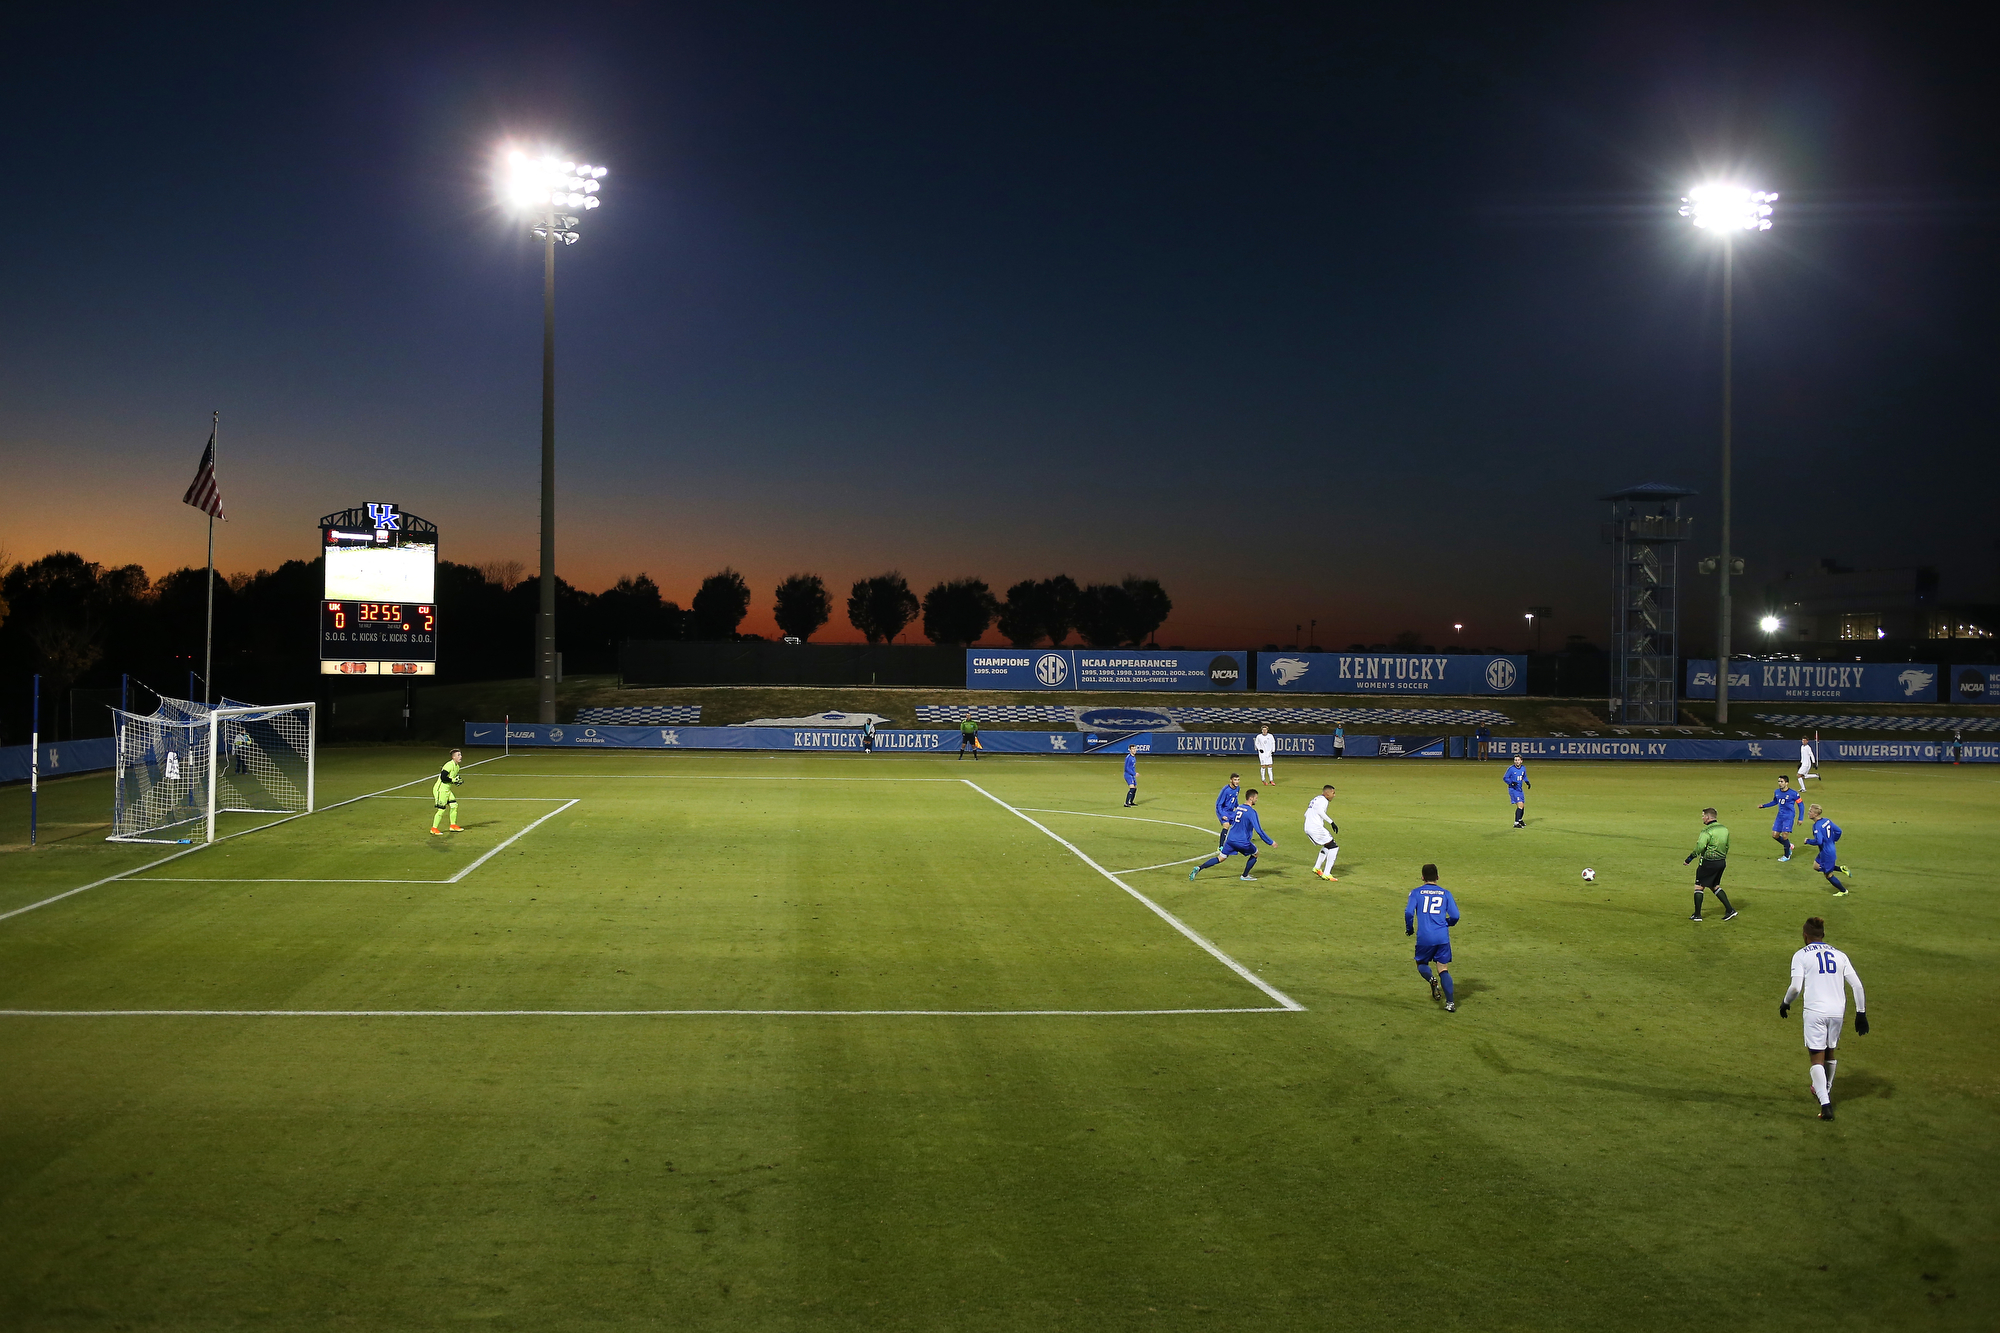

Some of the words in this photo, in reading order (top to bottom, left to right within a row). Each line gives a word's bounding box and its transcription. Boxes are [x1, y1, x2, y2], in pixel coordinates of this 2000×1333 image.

[367, 503, 399, 530] UK
[329, 603, 340, 611] UK
[418, 606, 430, 614] CU
[335, 612, 345, 629] 0
[424, 615, 433, 631] 2
[325, 632, 347, 641] S.O.G.
[359, 632, 378, 642] KICKS
[389, 633, 408, 642] KICKS
[411, 634, 432, 643] S.O.G.
[973, 658, 1030, 667] CHAMPIONS
[1082, 659, 1107, 667] NCAA
[1109, 659, 1178, 668] APPEARANCES
[1339, 657, 1448, 680] KENTUCKY
[1037, 655, 1065, 685] SEC
[1211, 670, 1239, 679] NCAA
[1487, 660, 1514, 688] SEC
[1762, 665, 1865, 688] KENTUCKY
[1397, 682, 1429, 690] SOCCER
[1959, 683, 1985, 692] NCAA
[1093, 718, 1170, 726] NCAA
[661, 730, 679, 745] UK
[794, 732, 864, 748] KENTUCKY
[874, 733, 939, 748] WILDCATS
[1049, 735, 1068, 751] UK
[1177, 736, 1246, 751] KENTUCKY
[1511, 742, 1546, 754] BELL
[1560, 743, 1644, 756] LEXINGTON,
[1648, 743, 1667, 754] KY
[1747, 742, 1763, 757] UK
[1839, 745, 1921, 757] UNIVERSITY
[1924, 745, 1942, 757] OF
[1422, 896, 1443, 914] 12
[1816, 951, 1837, 974] 16
